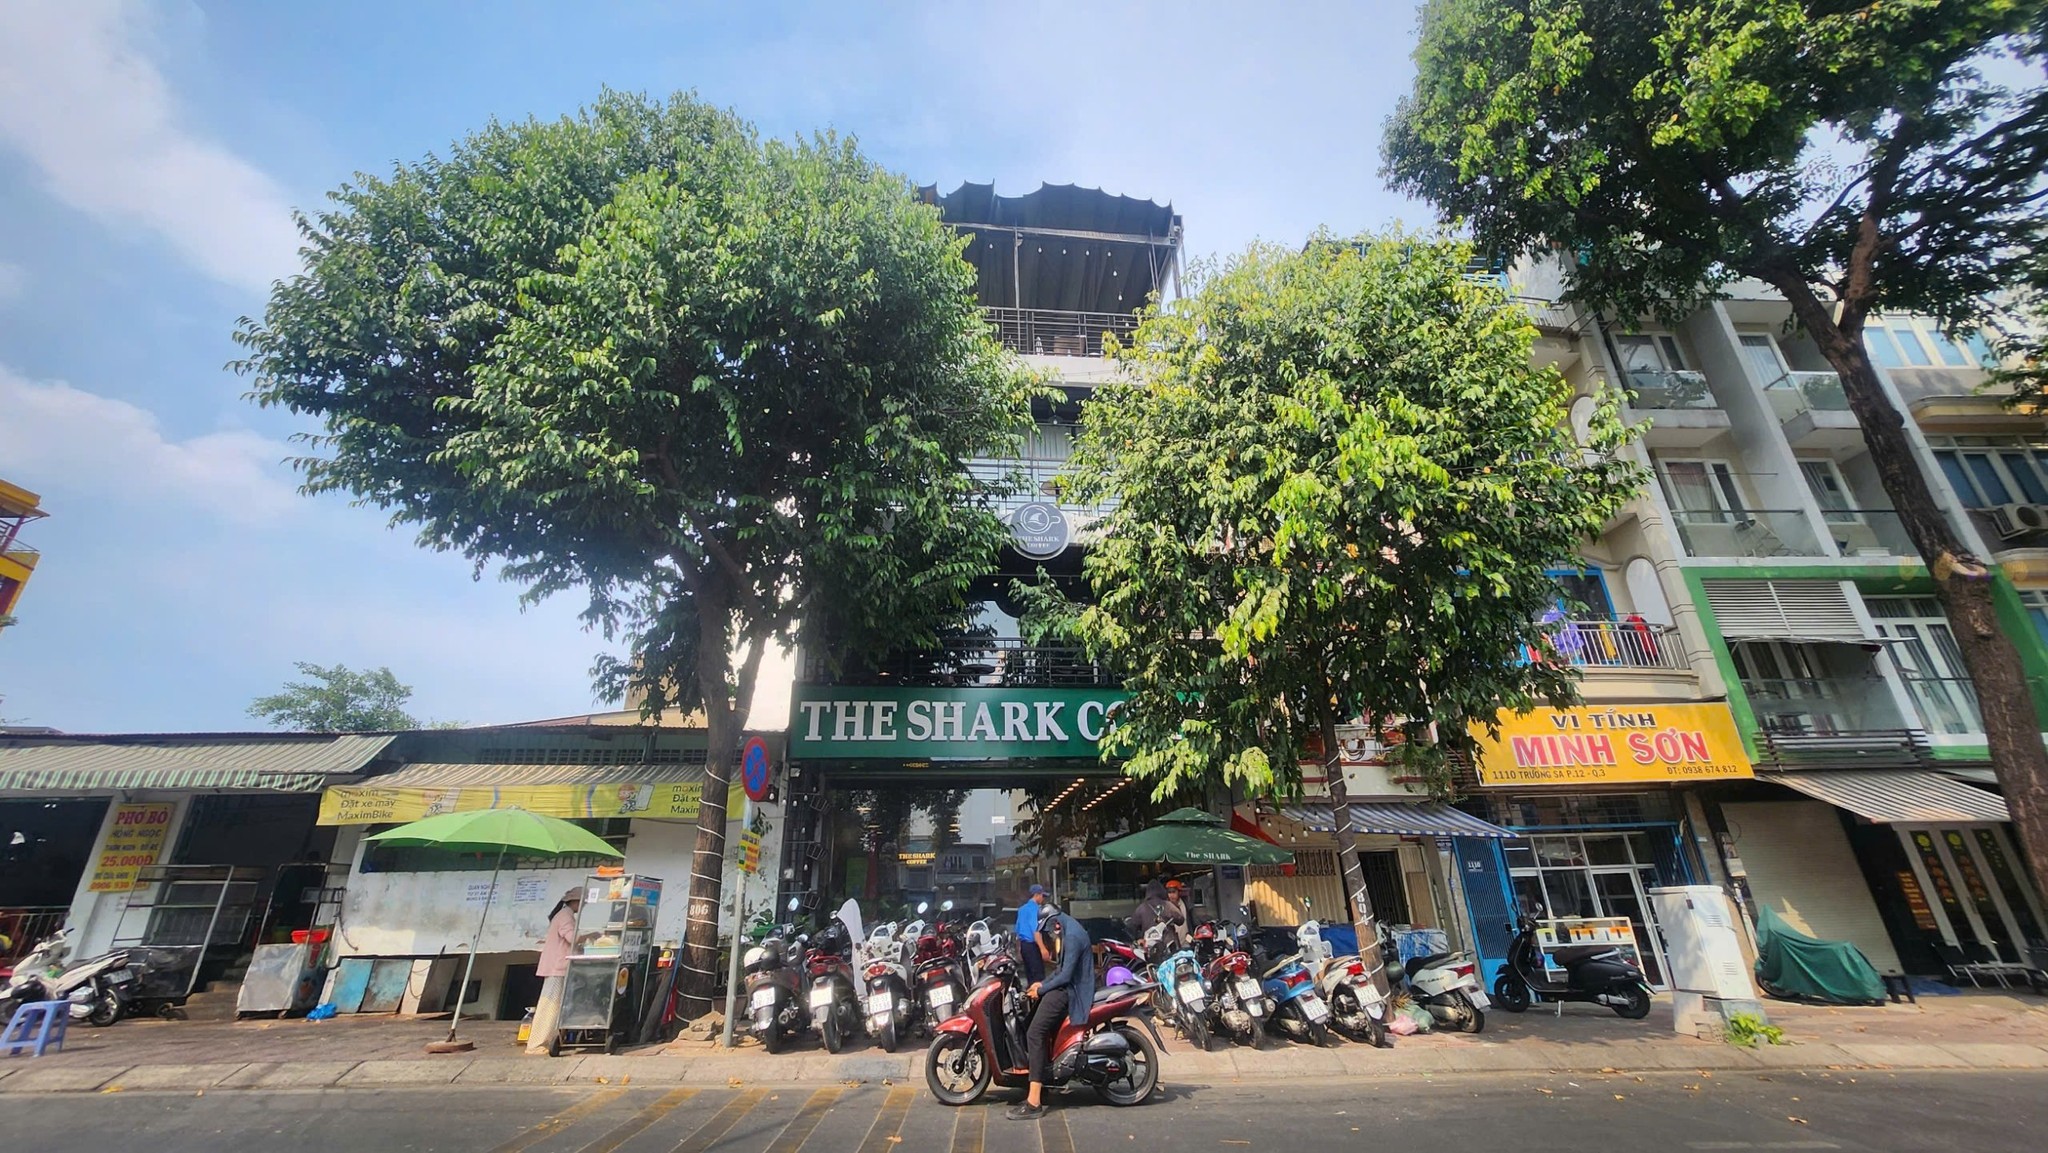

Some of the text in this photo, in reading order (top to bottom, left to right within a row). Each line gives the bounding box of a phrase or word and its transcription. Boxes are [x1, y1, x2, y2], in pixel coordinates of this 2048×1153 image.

[800, 700, 897, 742] THE
[907, 700, 1069, 742] SHARK
[1550, 708, 1657, 729] VI TÍNH
[1511, 728, 1712, 767] MINH SƠN
[1705, 765, 1721, 774] 674
[1722, 765, 1738, 774] 812
[1492, 770, 1516, 780] 1110
[1554, 770, 1565, 778] SA
[1567, 770, 1585, 778] P.12
[337, 811, 394, 820] MaximBike
[1203, 852, 1231, 860] SHARK
[689, 904, 709, 915] 806
